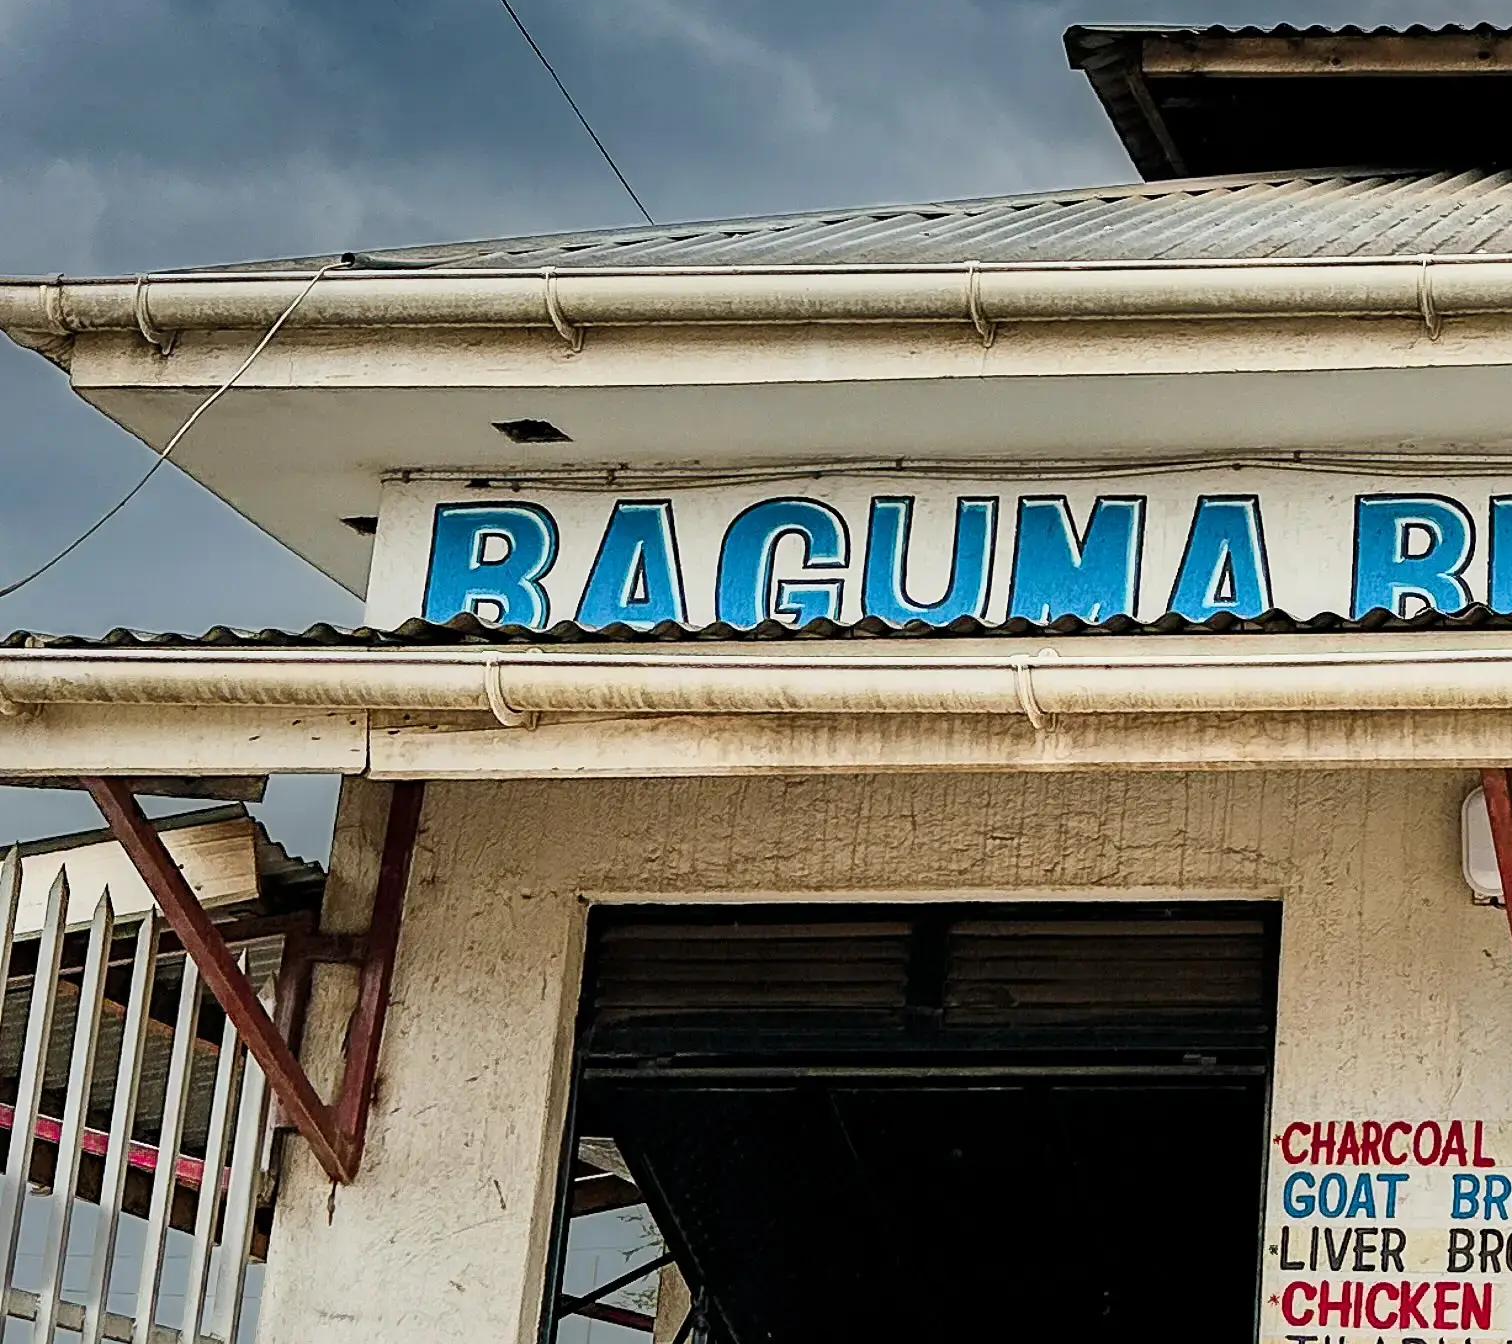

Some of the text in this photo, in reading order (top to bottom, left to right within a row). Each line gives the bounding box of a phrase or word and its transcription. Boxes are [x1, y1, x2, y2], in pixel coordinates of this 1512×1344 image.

[423, 494, 1275, 630] BAGUMA
[1281, 1120, 1495, 1167] CHARCOAL
[1284, 1171, 1410, 1218] GOAT
[1280, 1226, 1406, 1272] LIVER
[1282, 1280, 1492, 1331] CHICKEN
